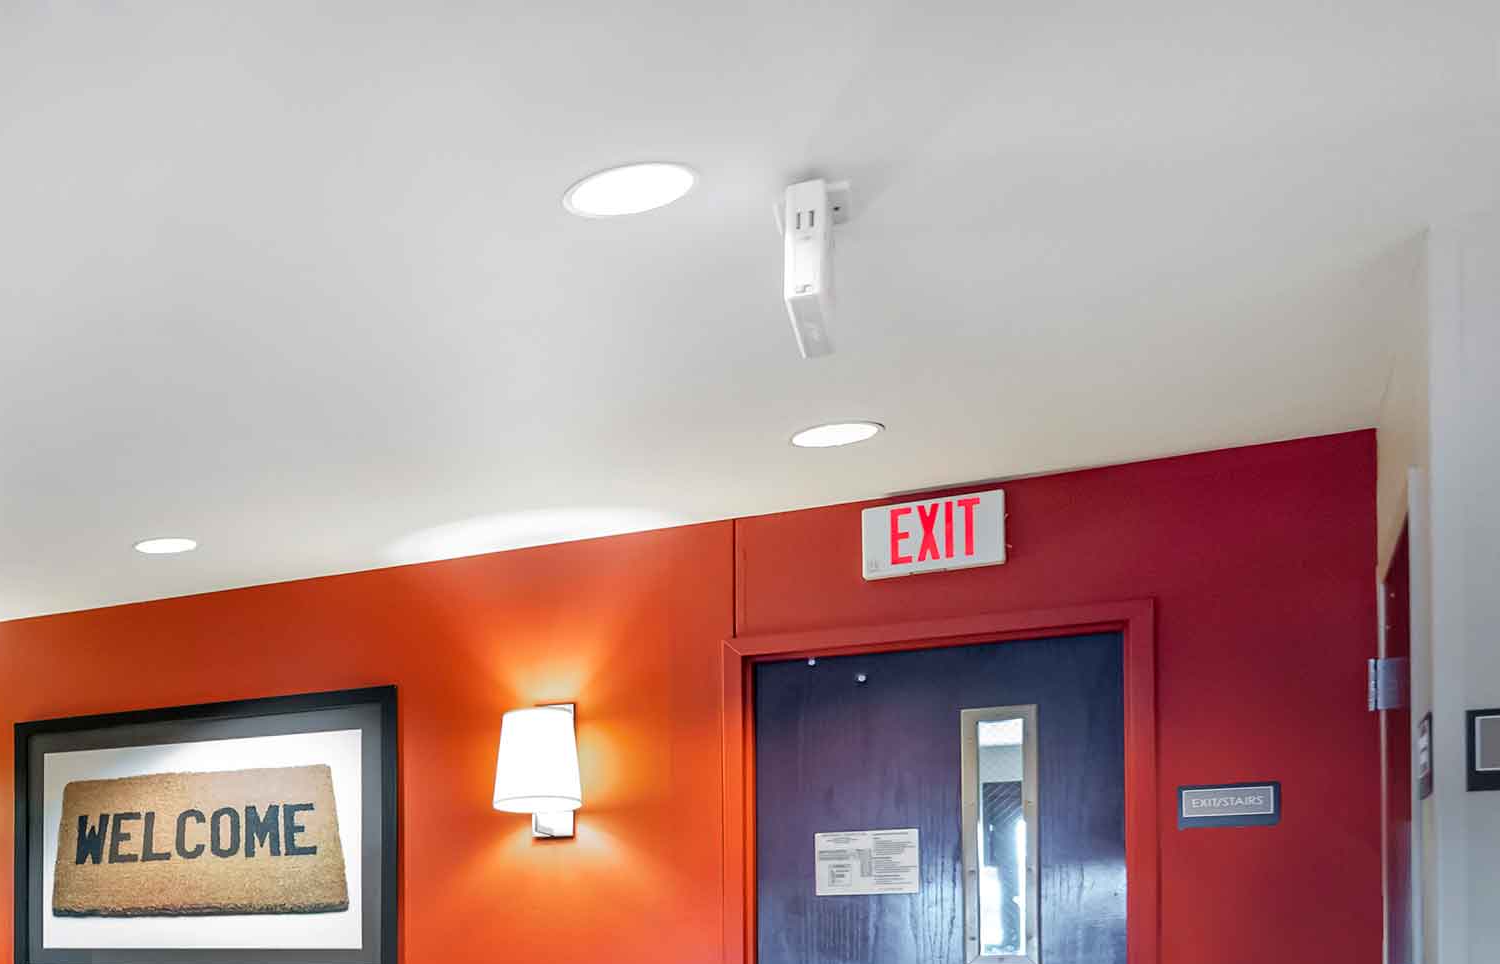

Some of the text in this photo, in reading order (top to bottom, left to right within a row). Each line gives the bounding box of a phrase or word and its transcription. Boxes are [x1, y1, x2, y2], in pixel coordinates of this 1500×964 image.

[890, 497, 980, 565] EXIT
[1191, 795, 1264, 808] EXIT/STAIRS
[75, 803, 317, 865] WELCOME
